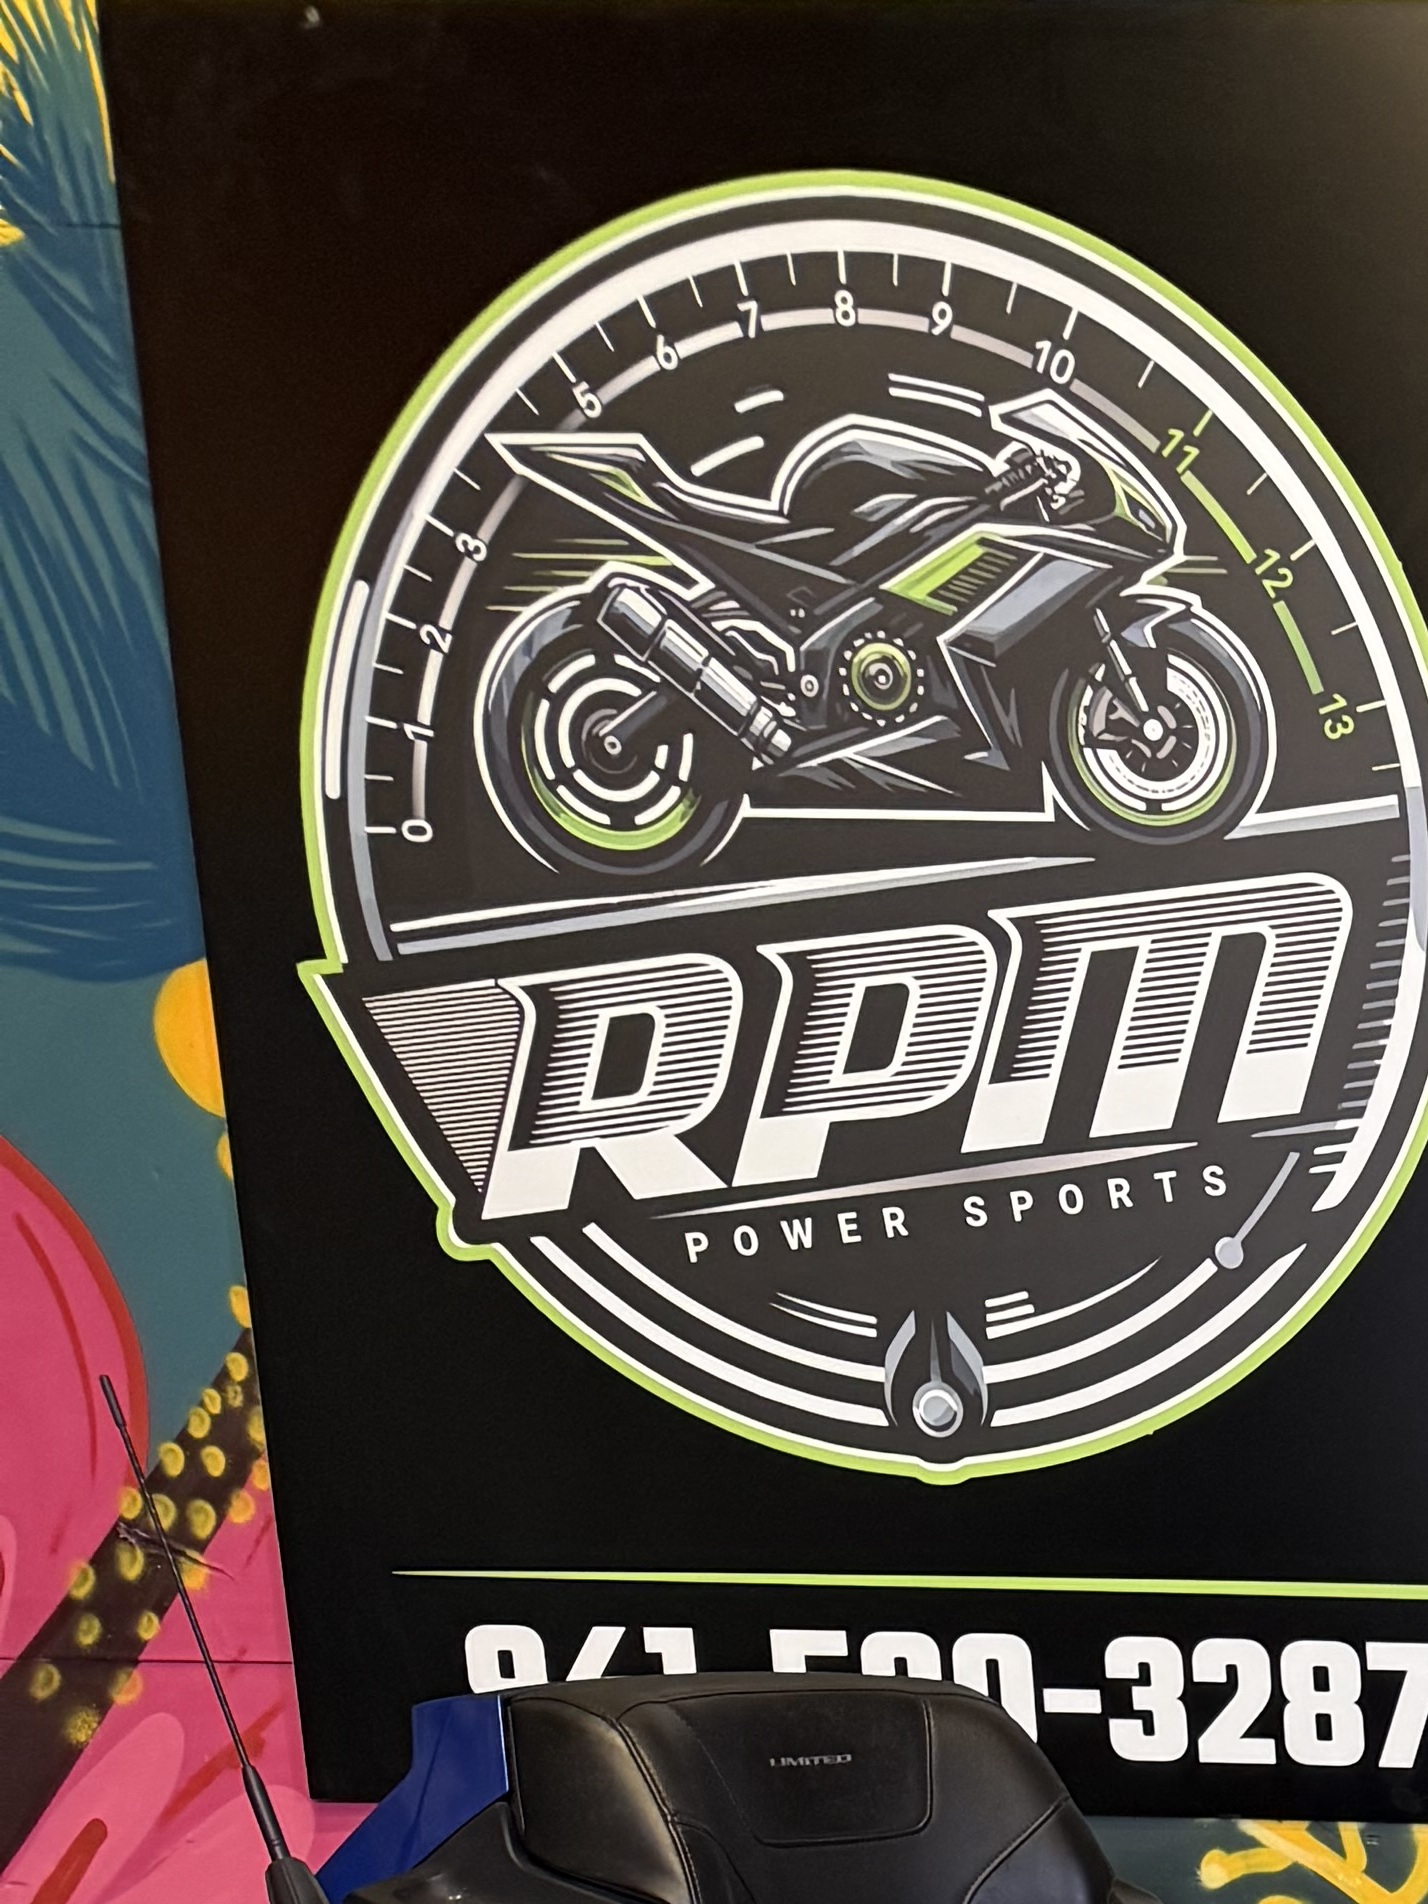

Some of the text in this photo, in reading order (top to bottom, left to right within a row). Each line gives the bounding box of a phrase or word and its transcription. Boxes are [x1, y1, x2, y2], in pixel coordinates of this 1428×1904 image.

[401, 289, 1356, 843] 0 1 2 3 5 6 7 8 9 10 11 12 13
[480, 870, 1354, 1220] RPM
[684, 1164, 1228, 1263] POWER SPORTS
[769, 1753, 853, 1767] LIMITED
